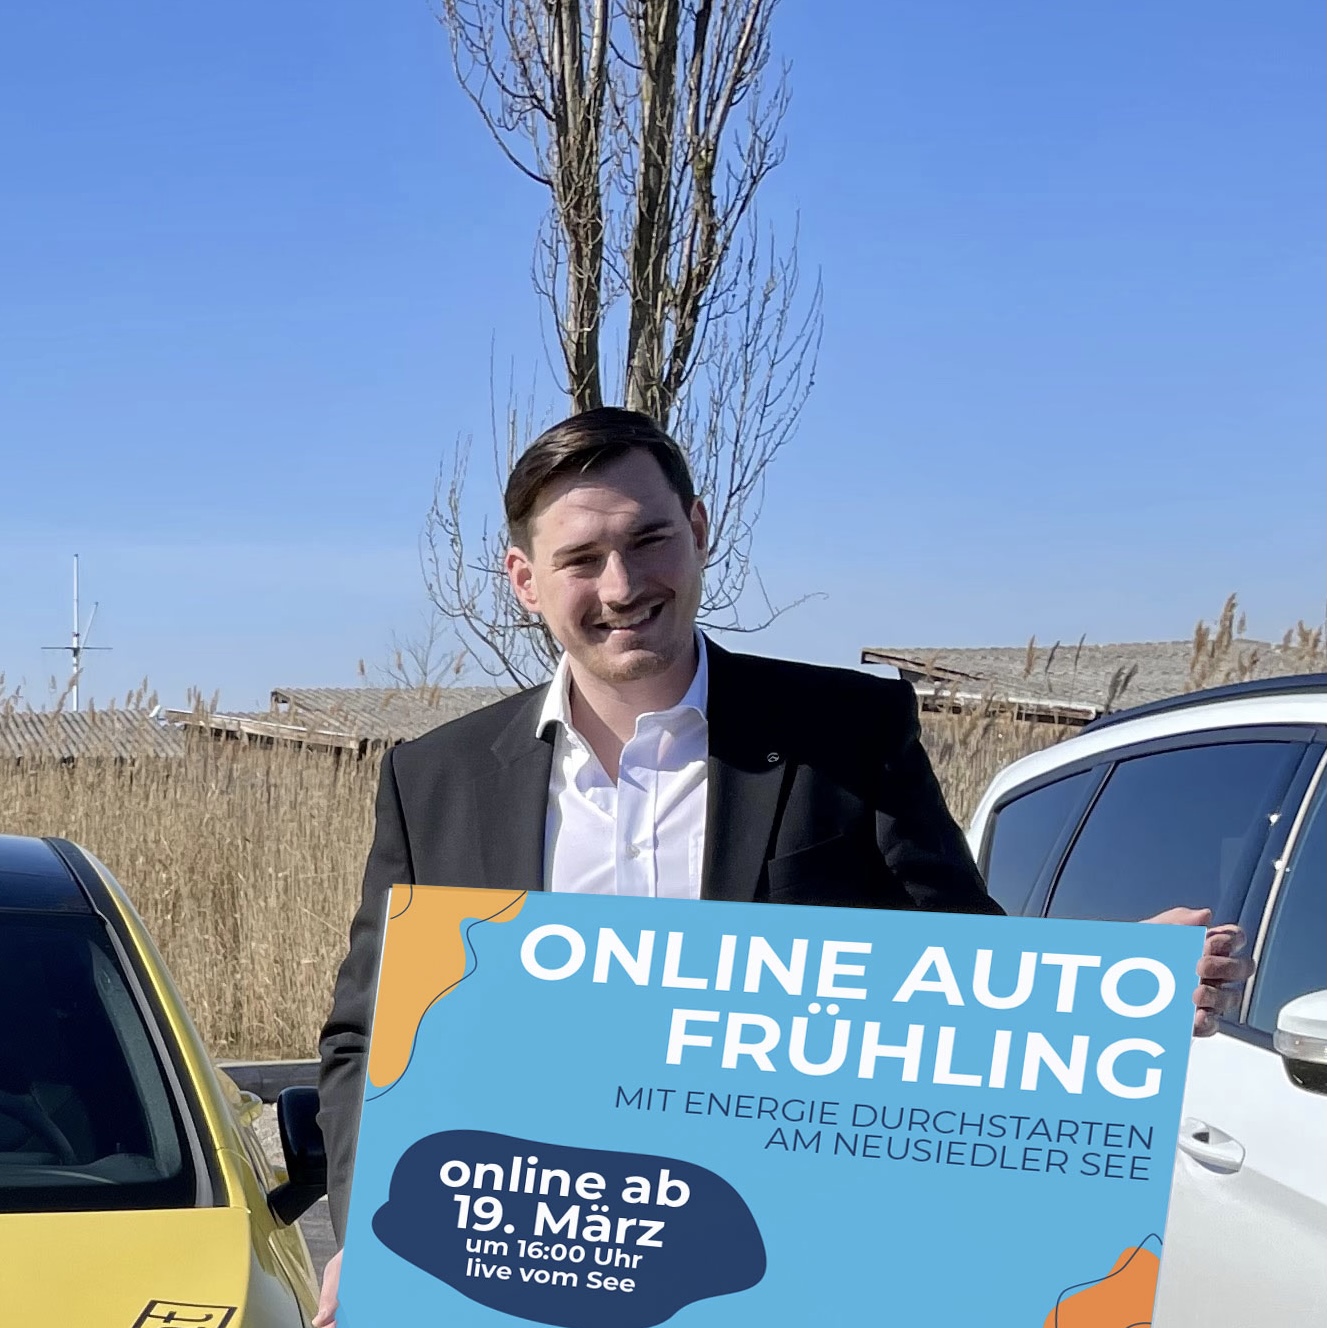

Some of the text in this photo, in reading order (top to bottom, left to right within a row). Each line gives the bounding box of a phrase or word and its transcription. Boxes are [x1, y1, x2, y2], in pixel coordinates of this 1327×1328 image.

[520, 923, 1176, 1019] ONLINE AUTO
[665, 1002, 1166, 1099] FRÜHLING
[615, 1085, 1154, 1151] MIT ENERGIE DURCHSTARTEN
[764, 1127, 1152, 1181] AM NEUSIEDLER SEE
[439, 1155, 691, 1208] online ab
[453, 1194, 665, 1248] 19. März
[465, 1238, 643, 1269] um 16:00 Uhr
[466, 1257, 636, 1293] live vom See
